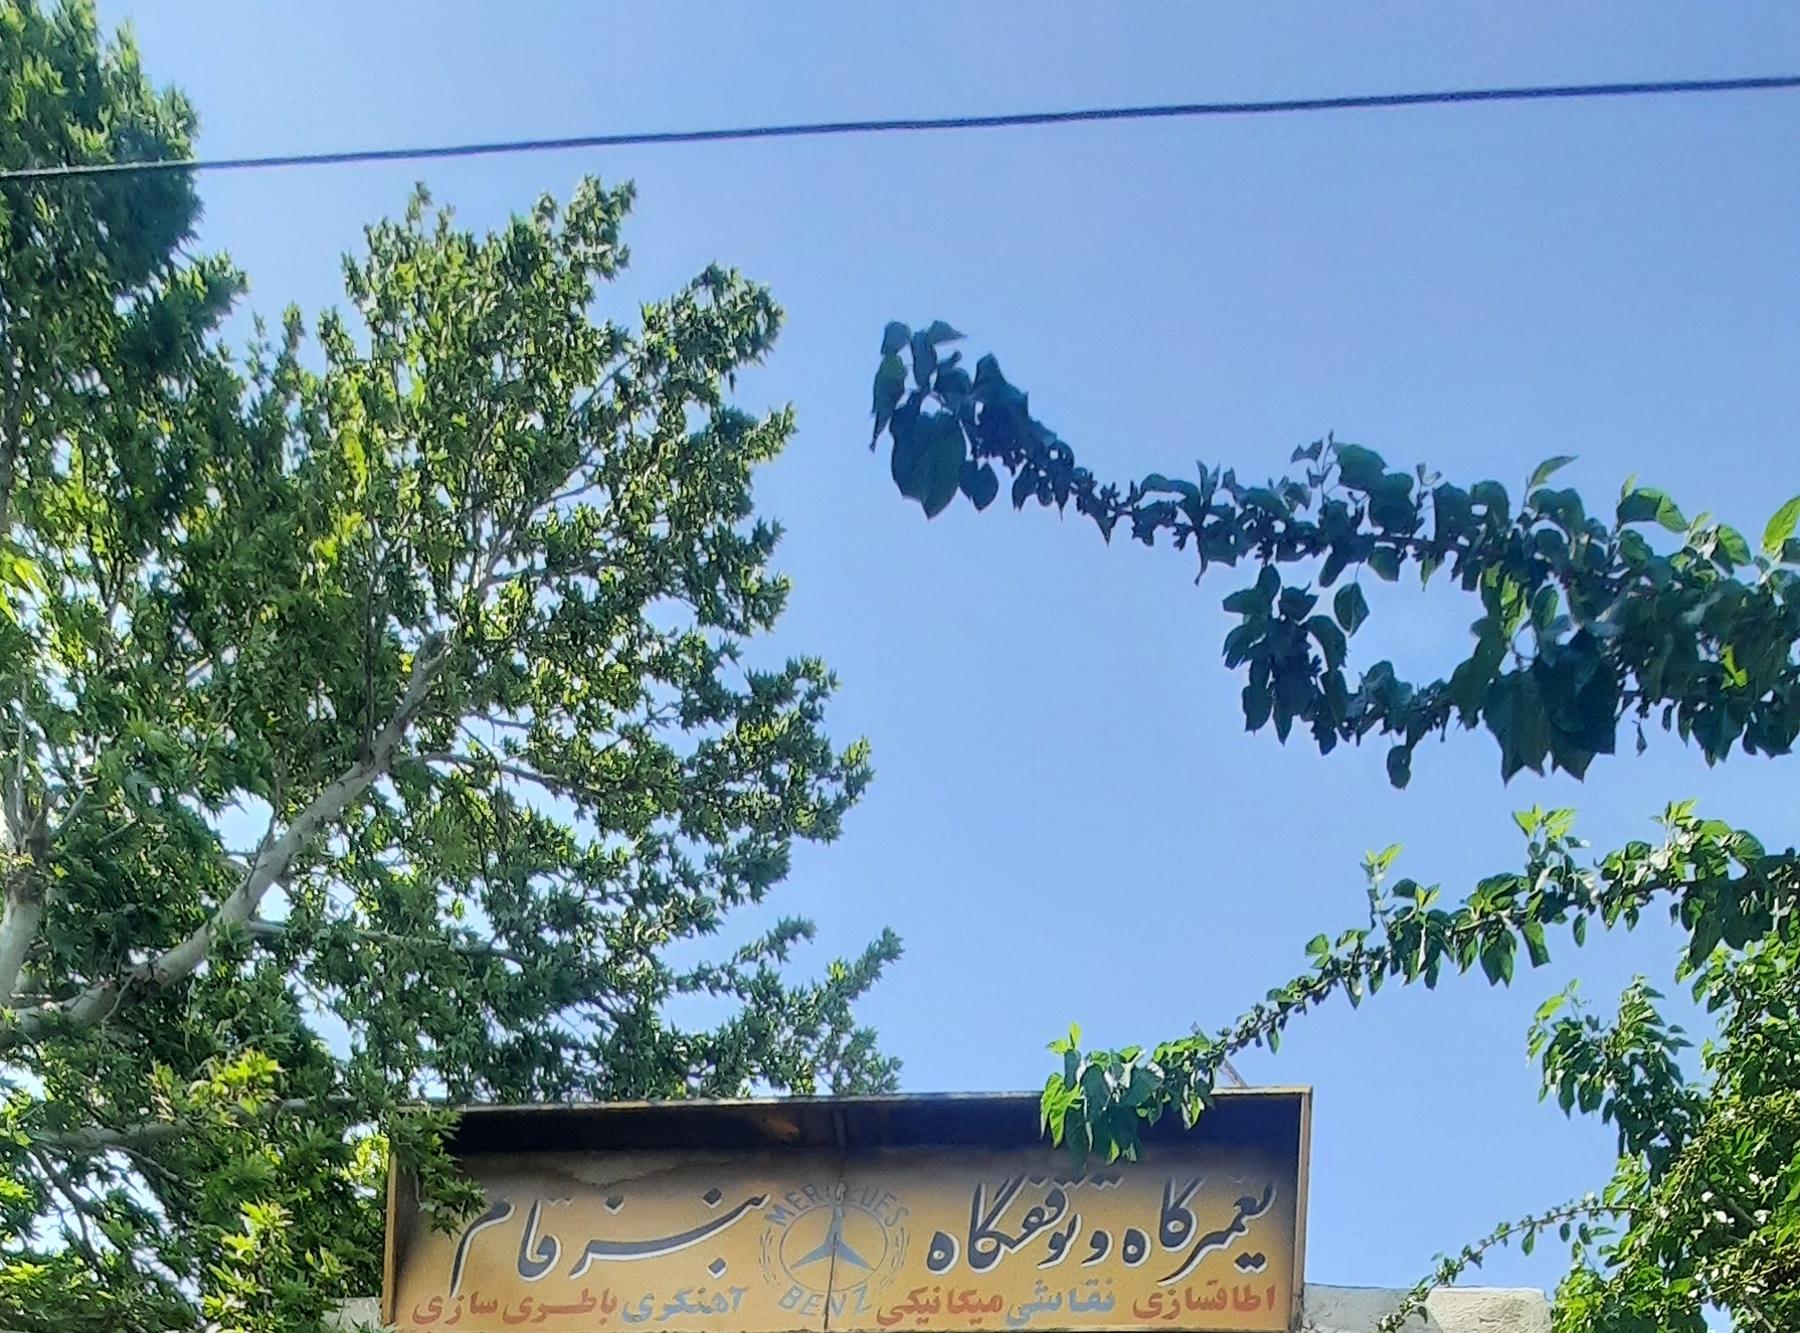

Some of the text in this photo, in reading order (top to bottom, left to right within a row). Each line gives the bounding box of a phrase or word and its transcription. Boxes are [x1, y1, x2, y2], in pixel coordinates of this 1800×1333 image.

[568, 1187, 771, 1281] بنز
[1081, 1228, 1113, 1269] و
[411, 1290, 499, 1326] سازی
[502, 1287, 619, 1326] باطری
[621, 1285, 750, 1325] آهنگری
[778, 1284, 872, 1318] BENZ
[875, 1285, 1003, 1327] میکانیکی
[1005, 1278, 1117, 1328] نقاشی
